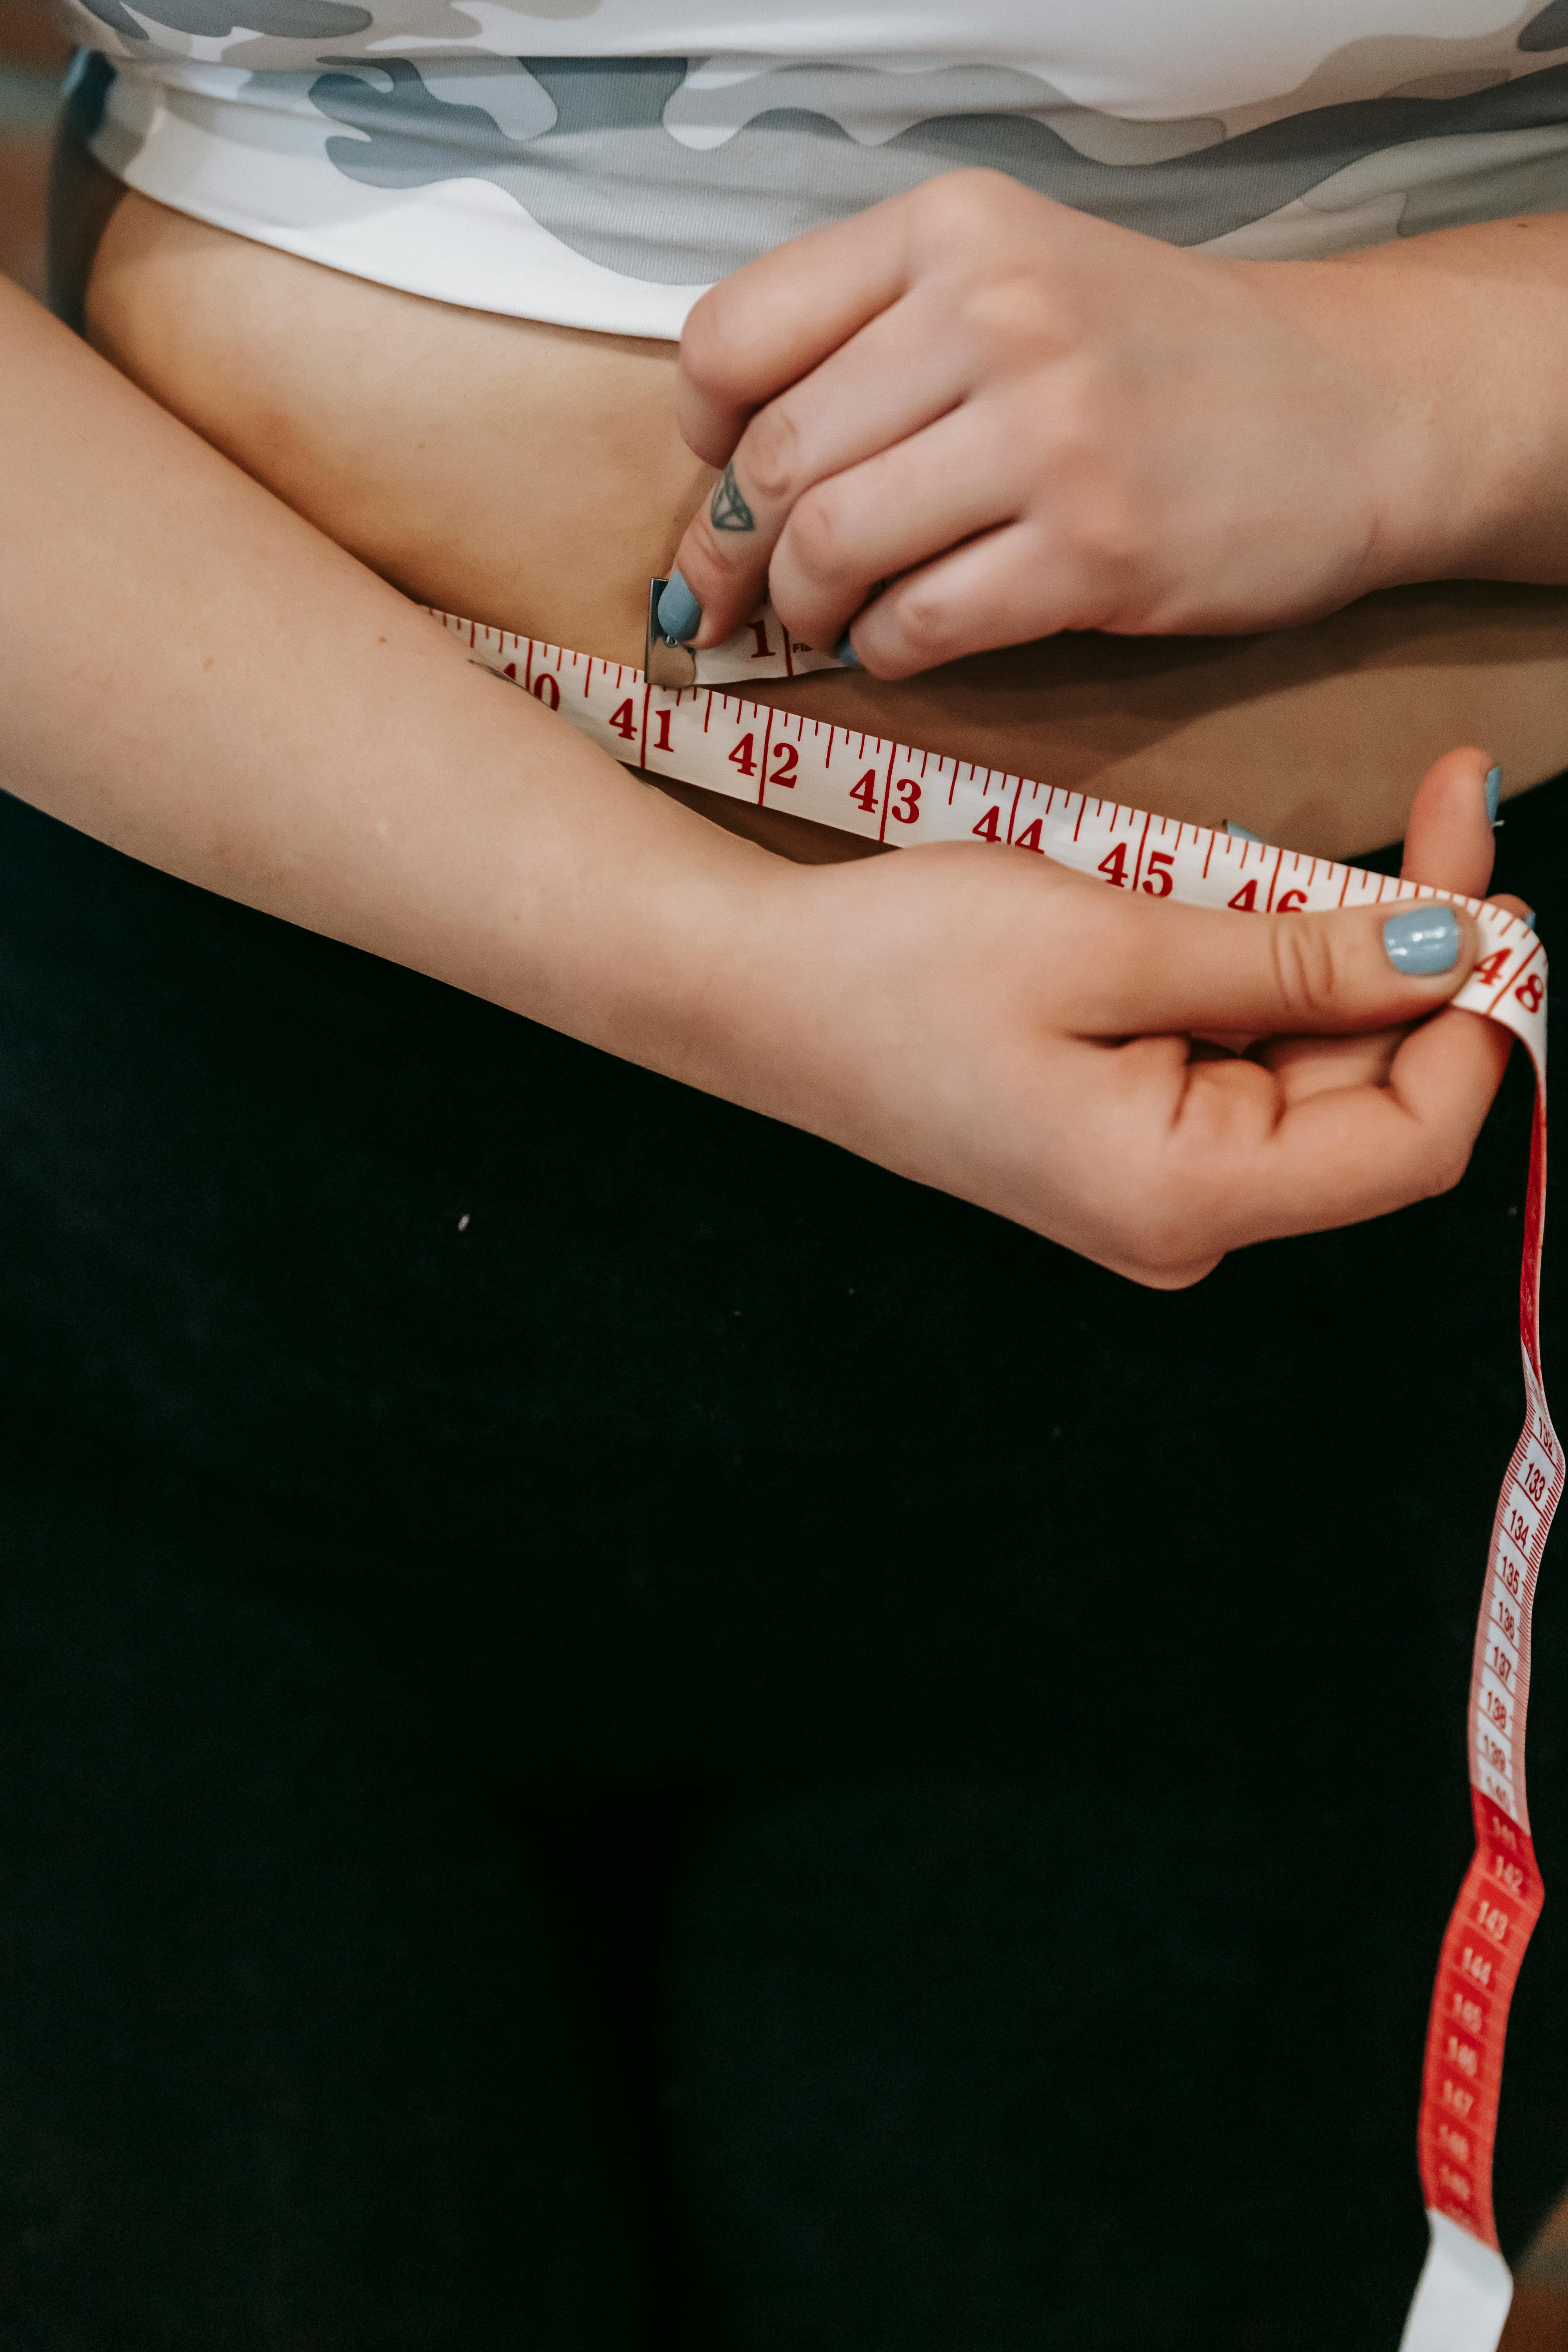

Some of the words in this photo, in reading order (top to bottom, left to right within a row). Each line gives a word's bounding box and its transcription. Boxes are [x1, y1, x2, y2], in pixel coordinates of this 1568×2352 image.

[745, 619, 775, 658] 1
[609, 698, 674, 752] 41
[728, 733, 799, 789] 42
[849, 769, 921, 824] 43
[1098, 842, 1174, 898] 45
[1473, 948, 1543, 1013] 48
[1525, 1463, 1546, 1502] 133
[1510, 1510, 1529, 1548] 134
[1503, 1556, 1519, 1595] 135
[1498, 1601, 1515, 1640] 136
[1494, 1647, 1512, 1681] 137
